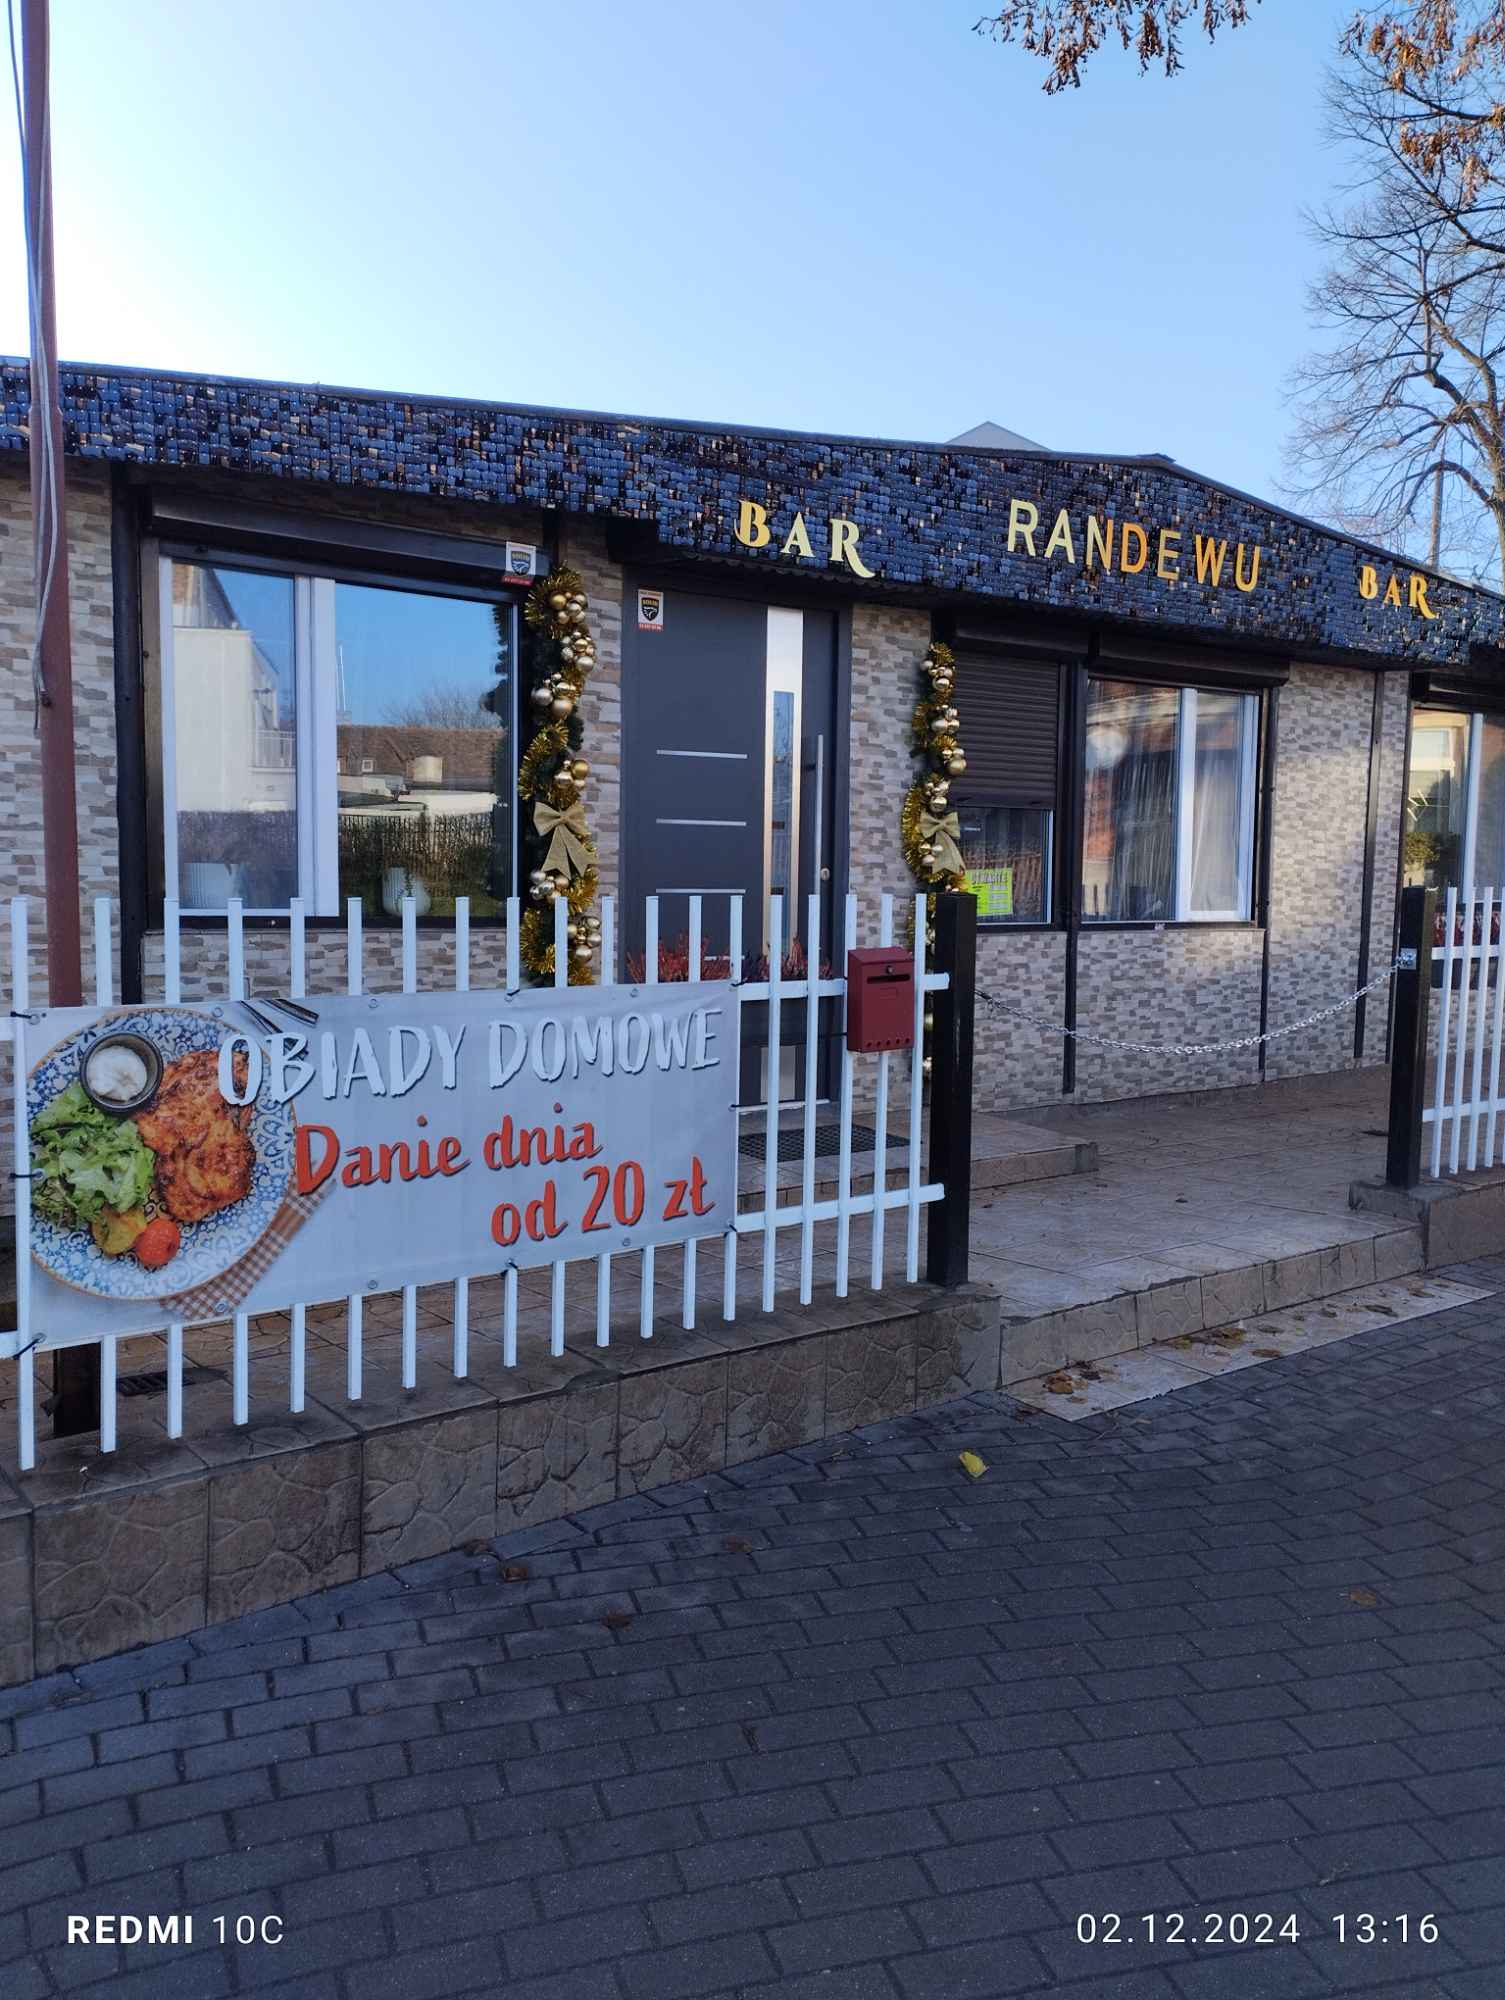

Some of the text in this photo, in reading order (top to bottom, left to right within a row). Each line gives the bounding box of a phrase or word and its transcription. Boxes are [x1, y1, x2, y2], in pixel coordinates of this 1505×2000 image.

[733, 498, 1261, 592] BAR RANDEWU
[1359, 564, 1436, 619] BAR
[218, 1008, 725, 1107] OBIADY DOMOWE
[297, 1102, 603, 1196] Danie dnia
[490, 1155, 716, 1248] od 20 zł
